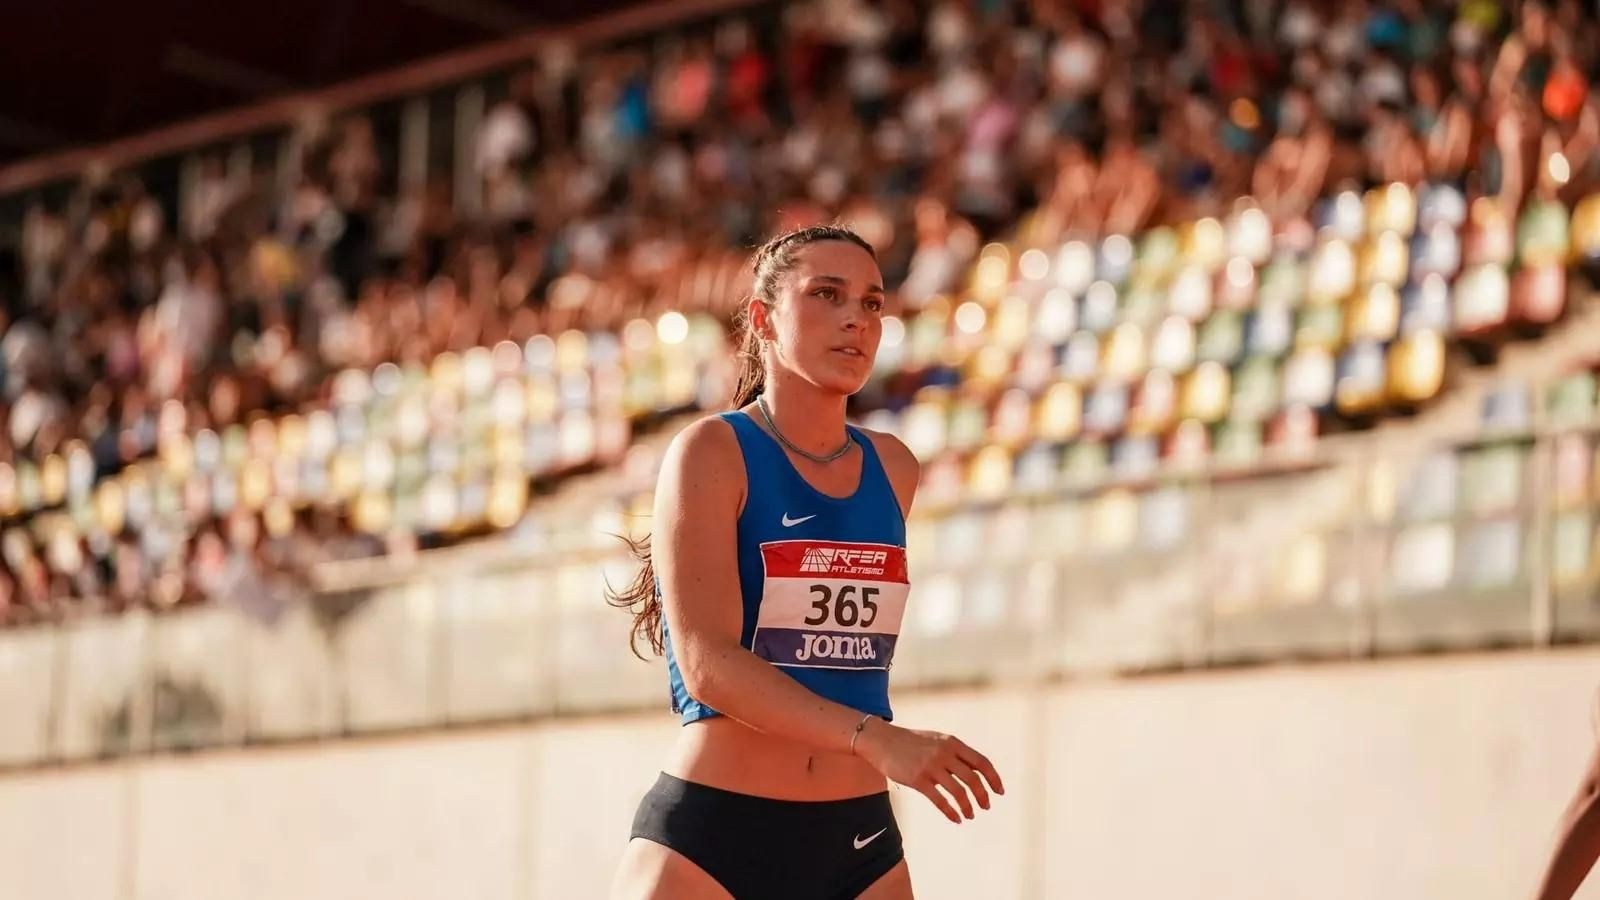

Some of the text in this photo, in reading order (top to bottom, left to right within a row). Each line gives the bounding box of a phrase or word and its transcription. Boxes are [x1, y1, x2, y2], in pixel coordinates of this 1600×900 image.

[833, 549, 887, 566] RFEA
[831, 565, 884, 575] ATLETISMO
[804, 584, 880, 628] 365
